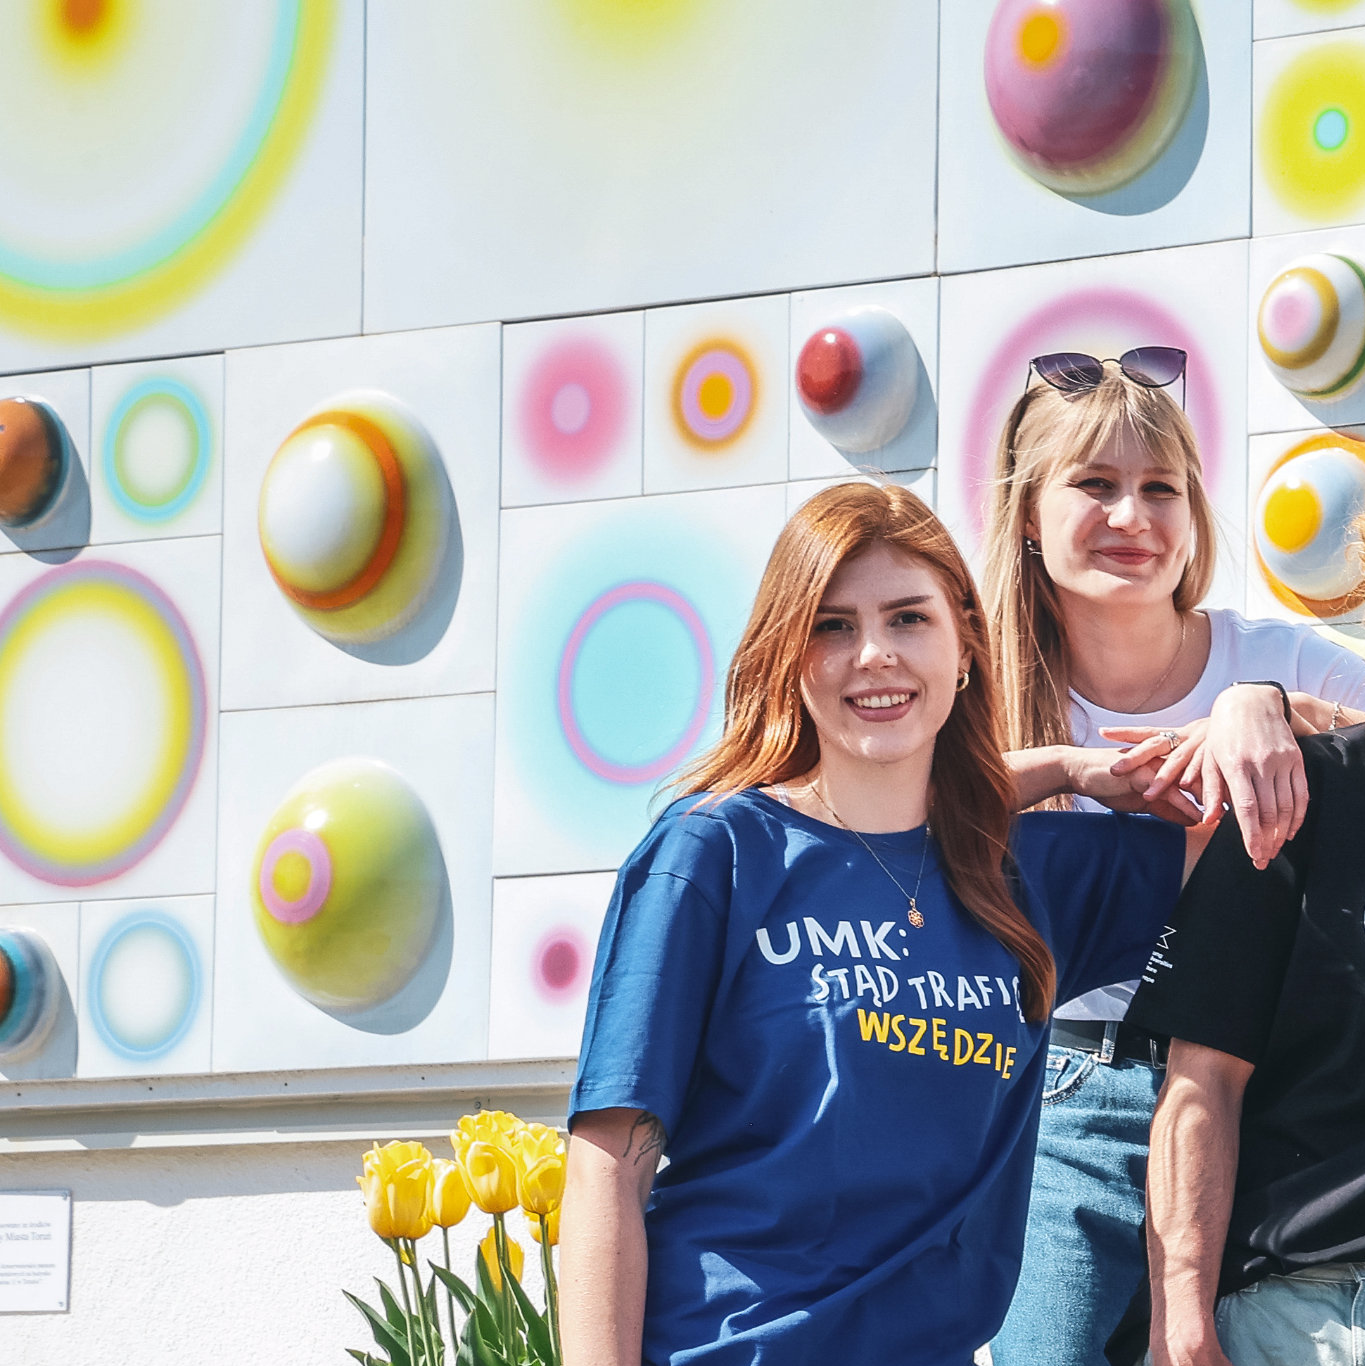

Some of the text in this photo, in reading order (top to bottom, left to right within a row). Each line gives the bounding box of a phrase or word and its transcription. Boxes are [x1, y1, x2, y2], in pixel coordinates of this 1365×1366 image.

[756, 917, 909, 965] UMK:
[810, 963, 1026, 1023] STĄD TRAFI
[856, 1008, 1017, 1079] WSZĘDZIE
